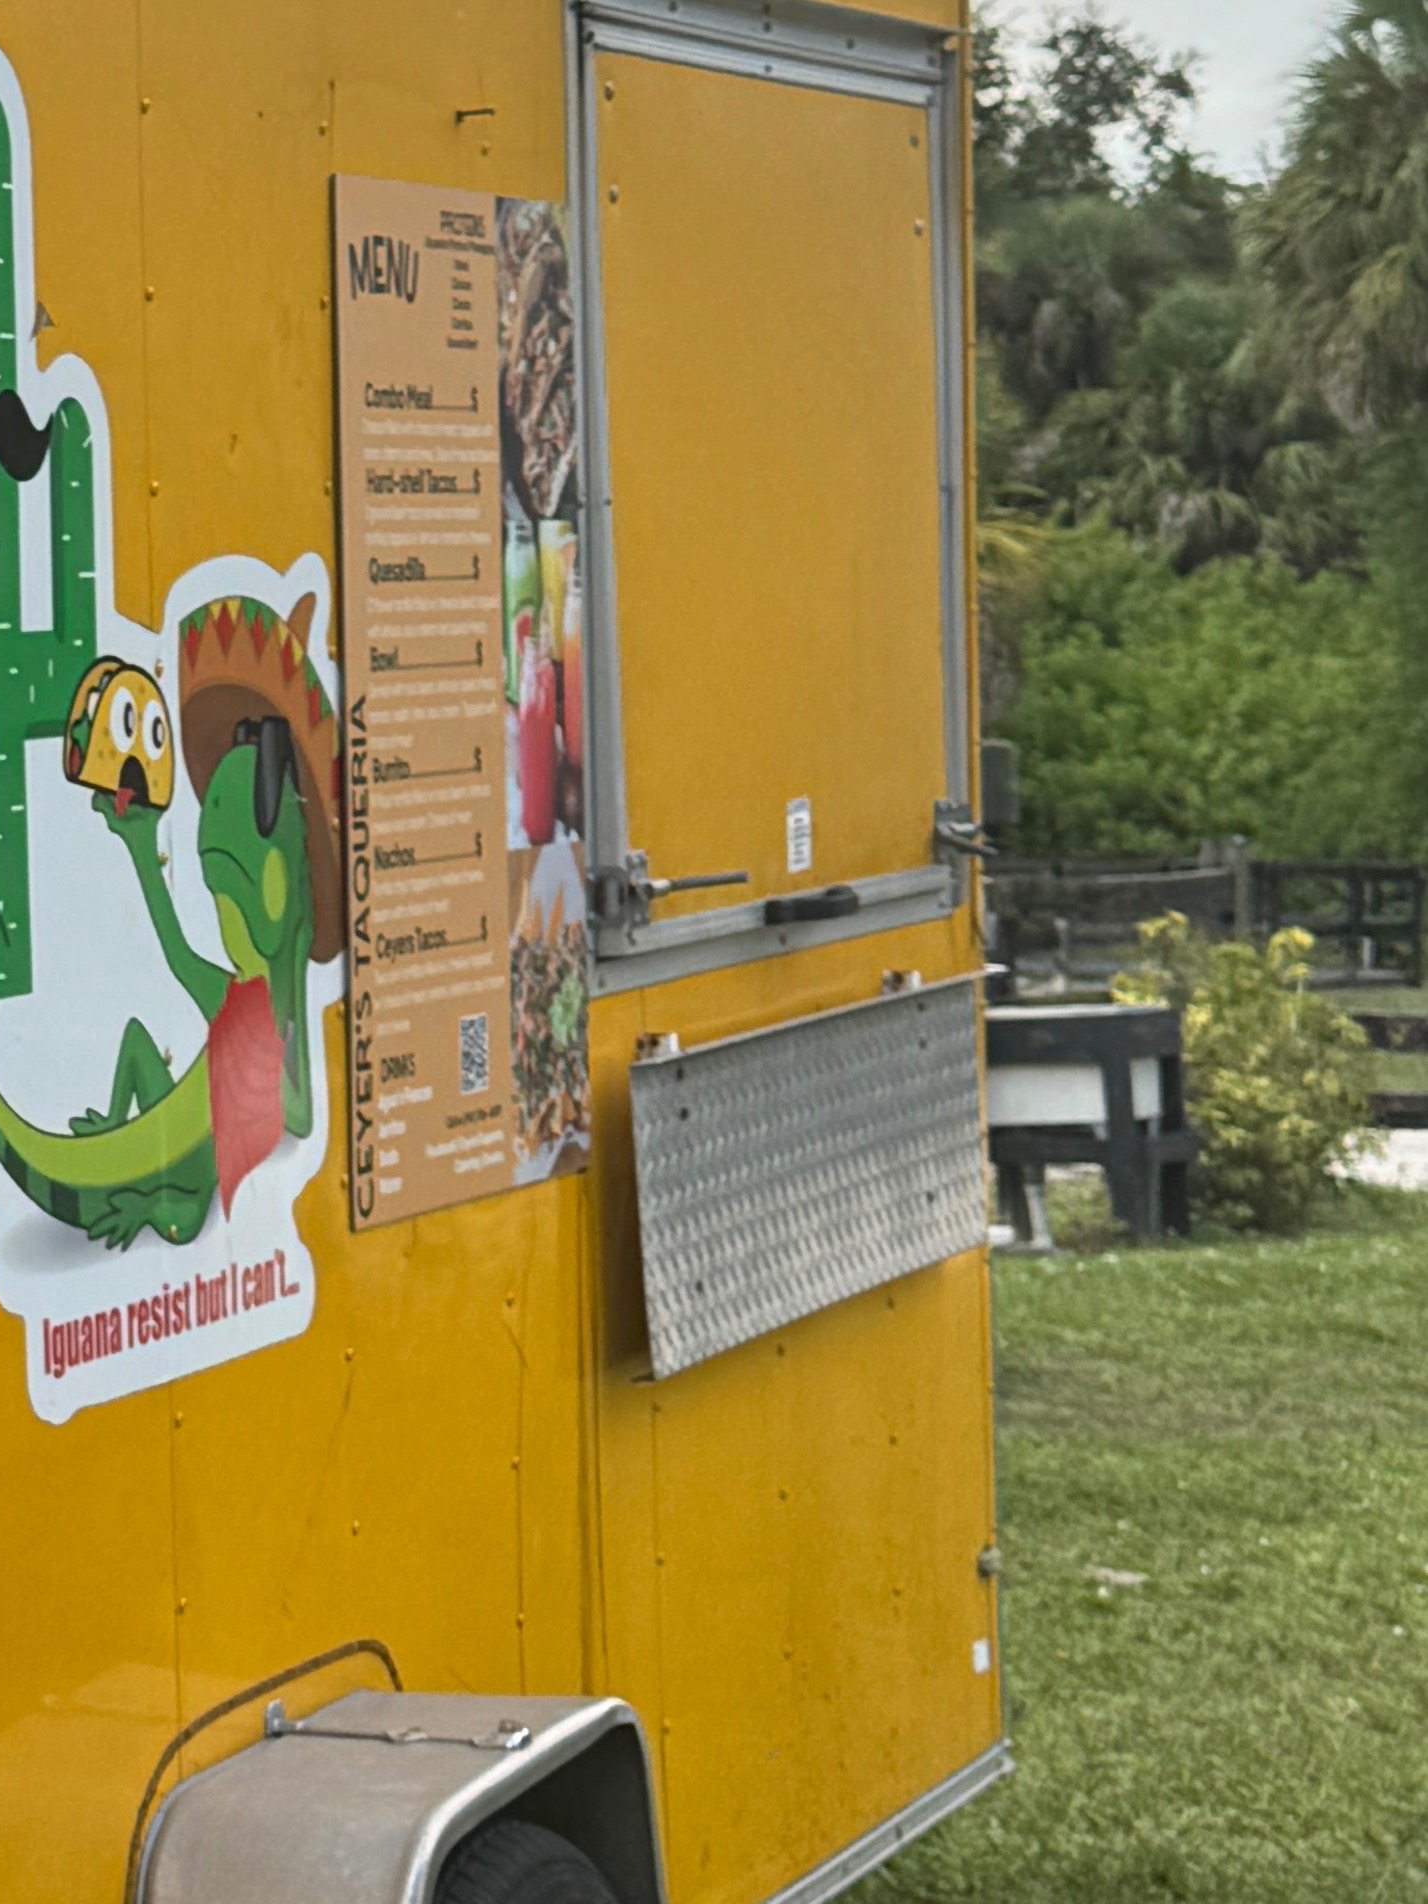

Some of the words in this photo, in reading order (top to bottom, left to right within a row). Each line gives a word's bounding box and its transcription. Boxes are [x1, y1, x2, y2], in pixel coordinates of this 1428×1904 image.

[347, 234, 420, 305] MENU
[363, 382, 405, 409] Combo
[405, 383, 433, 409] Meal
[365, 468, 425, 494] Hard-shell
[425, 469, 457, 494] Tacos
[368, 556, 426, 585] Quesadilla
[369, 645, 399, 673] Bowl
[372, 757, 411, 784] Burrito
[350, 695, 371, 977] TAQUERIA
[373, 843, 415, 871] Nachos
[415, 927, 447, 951] Tacos
[355, 990, 375, 1218] CEYER'S
[42, 1307, 124, 1379] Iguana
[126, 1282, 192, 1350] resist
[194, 1269, 229, 1328] but
[230, 1262, 238, 1317] I
